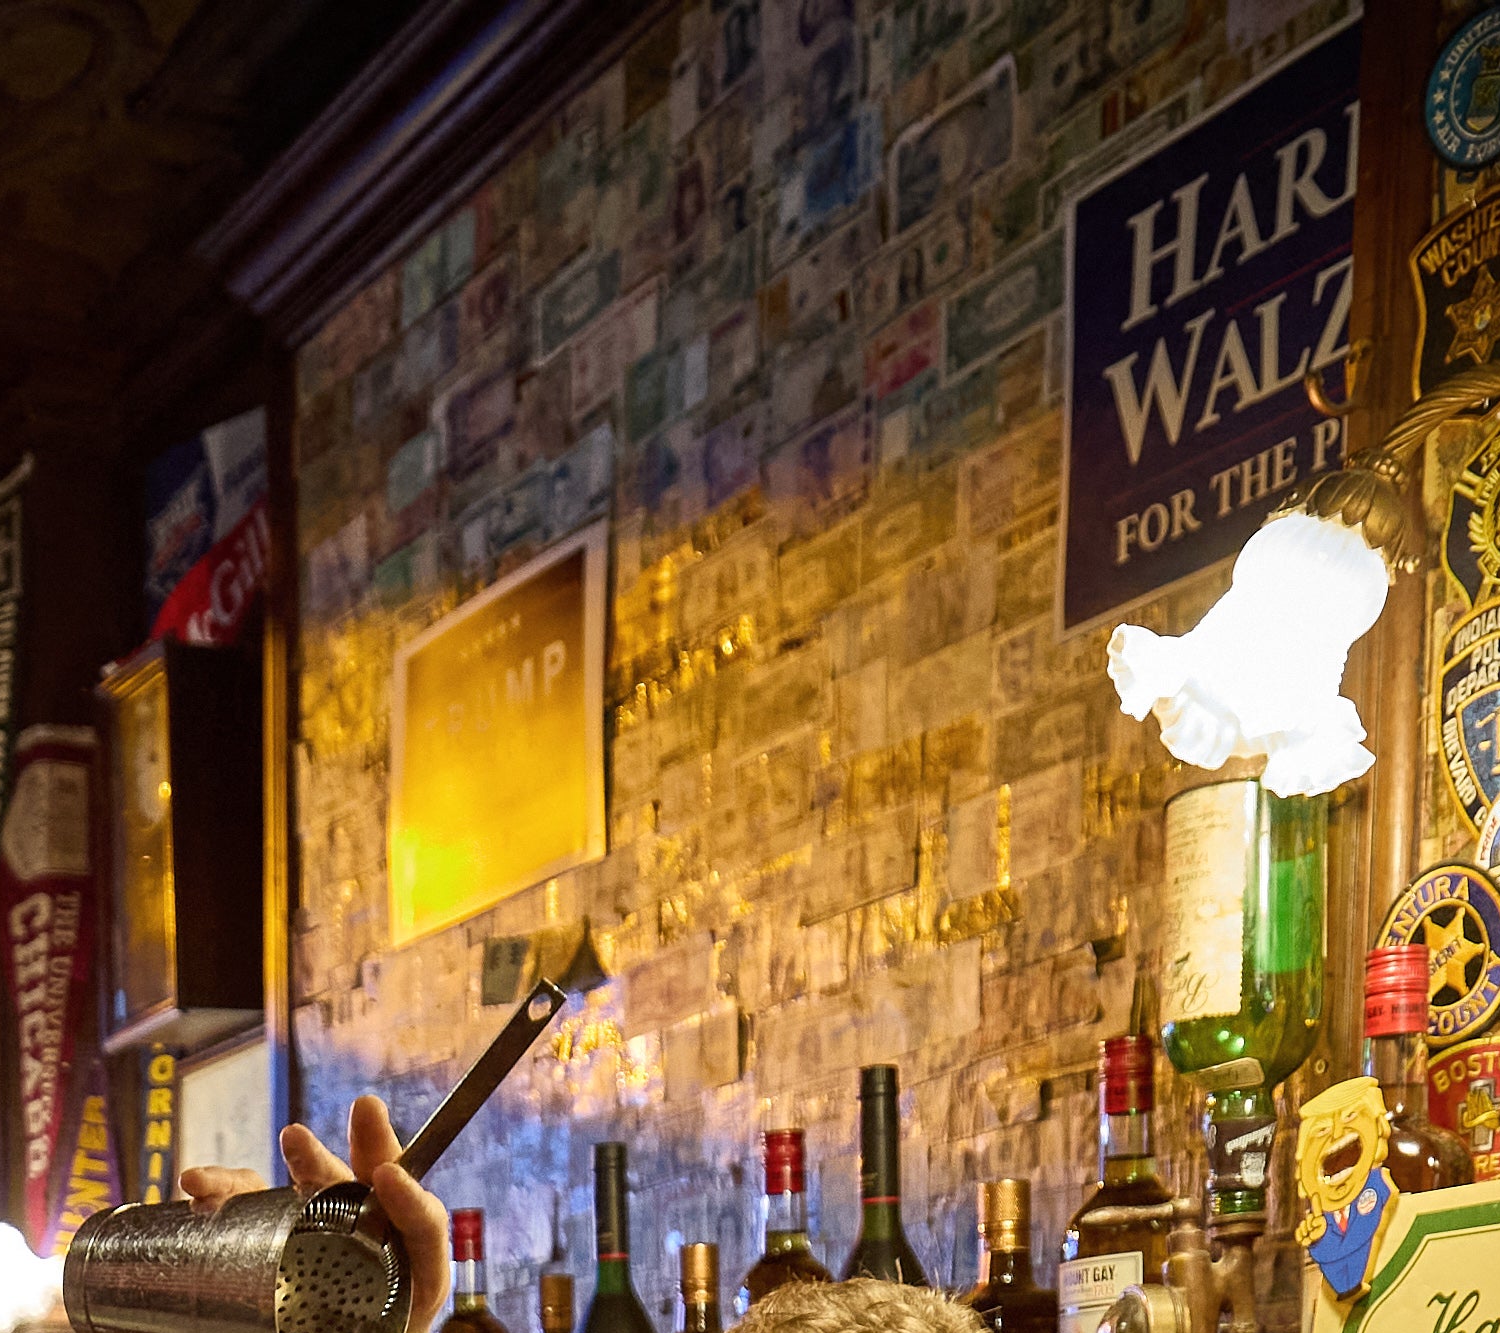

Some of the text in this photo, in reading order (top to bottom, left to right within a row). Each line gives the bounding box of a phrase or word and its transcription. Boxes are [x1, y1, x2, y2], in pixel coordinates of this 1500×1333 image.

[1121, 98, 1361, 333] HAR
[1116, 438, 1298, 566] FOR THE
